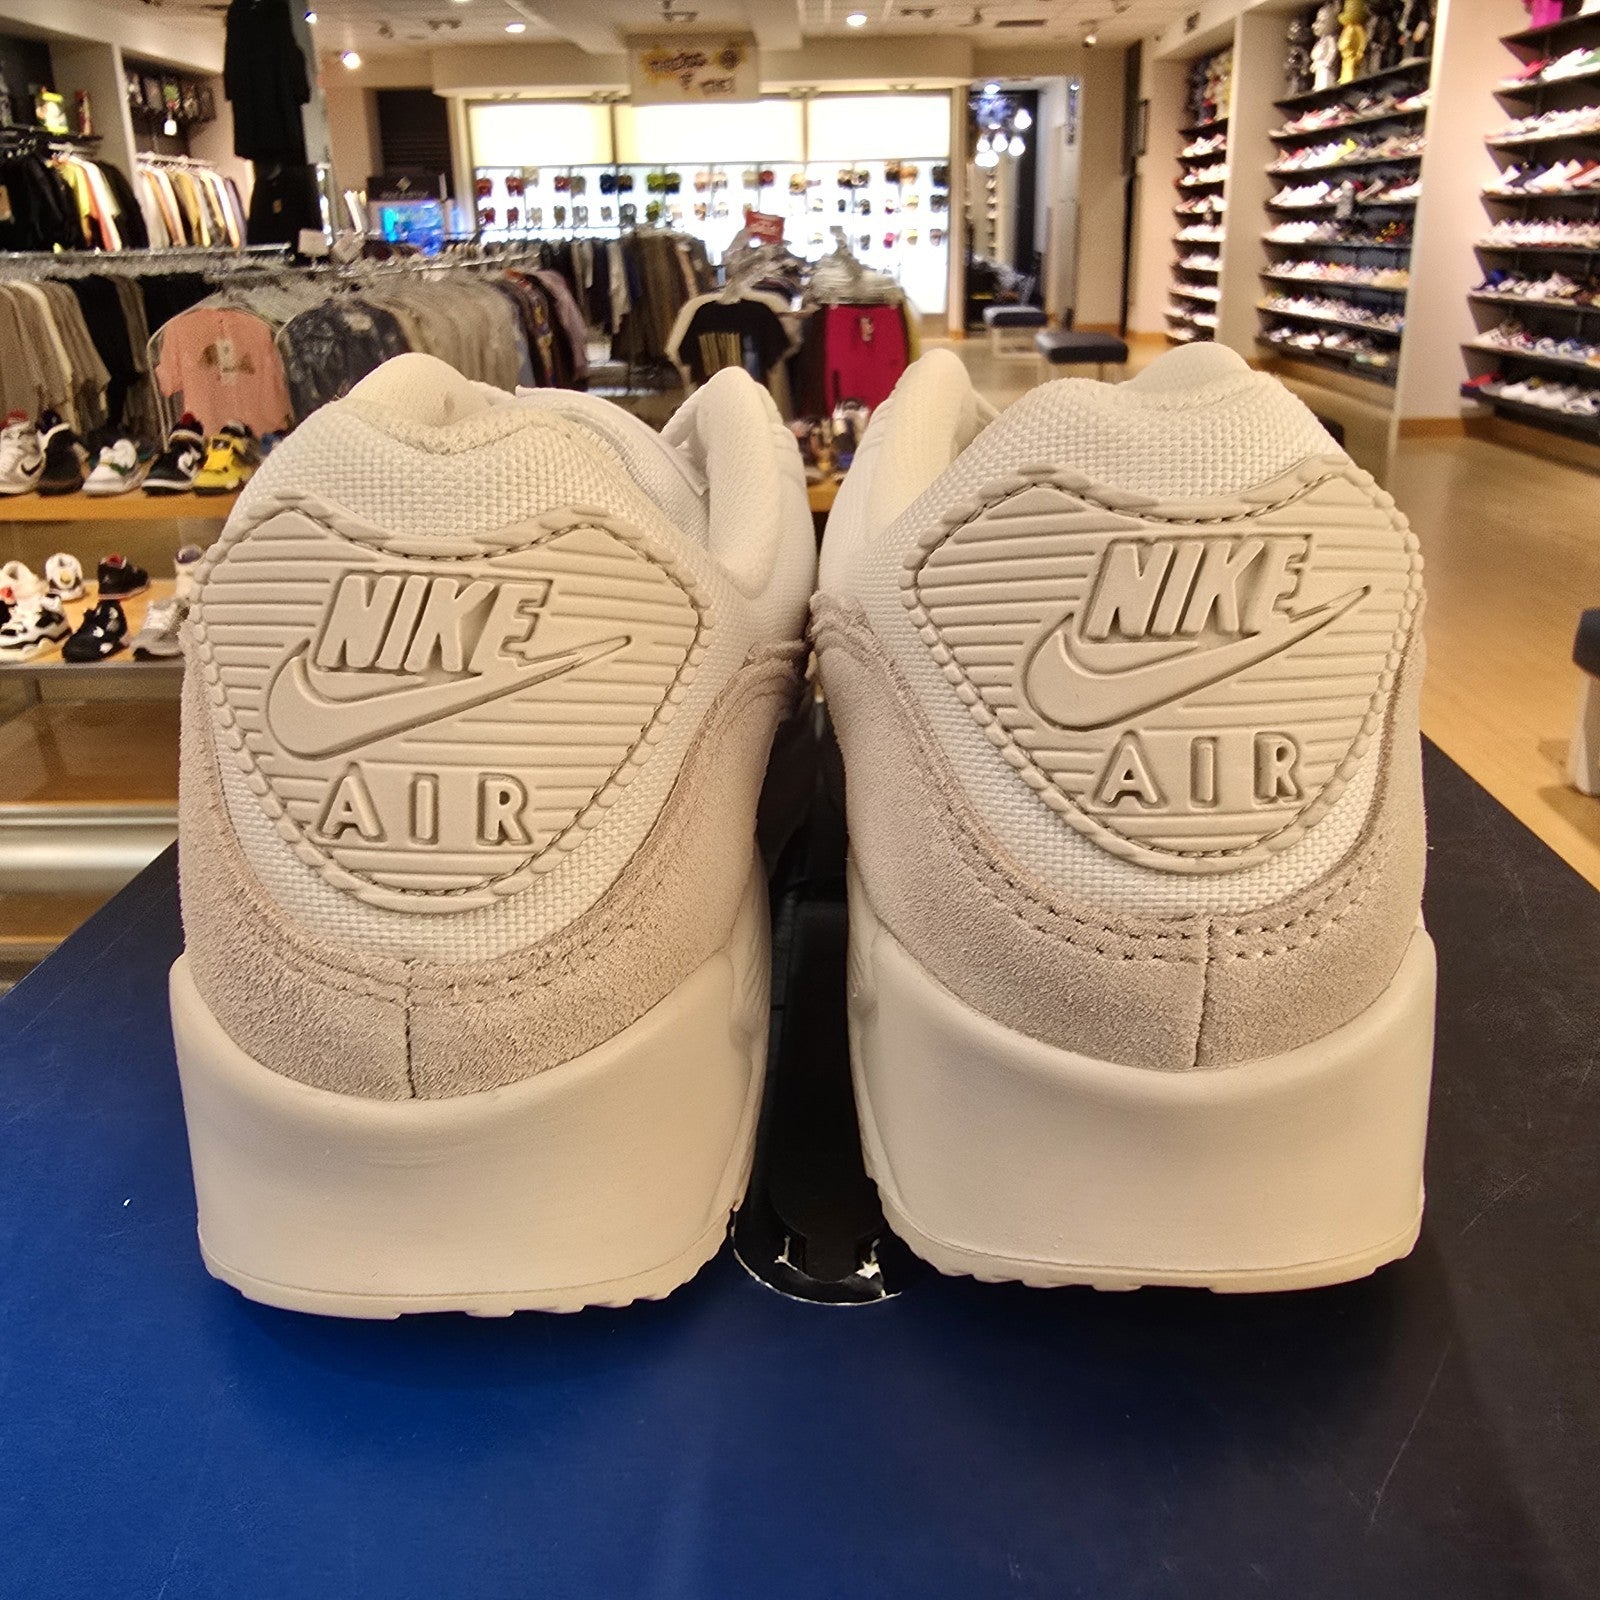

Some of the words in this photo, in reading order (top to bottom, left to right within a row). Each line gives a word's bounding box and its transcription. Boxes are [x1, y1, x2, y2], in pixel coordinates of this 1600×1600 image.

[317, 573, 552, 674] NIKE
[1085, 537, 1311, 640] NIKE
[319, 768, 533, 845] AIR
[1097, 733, 1302, 807] AIR
